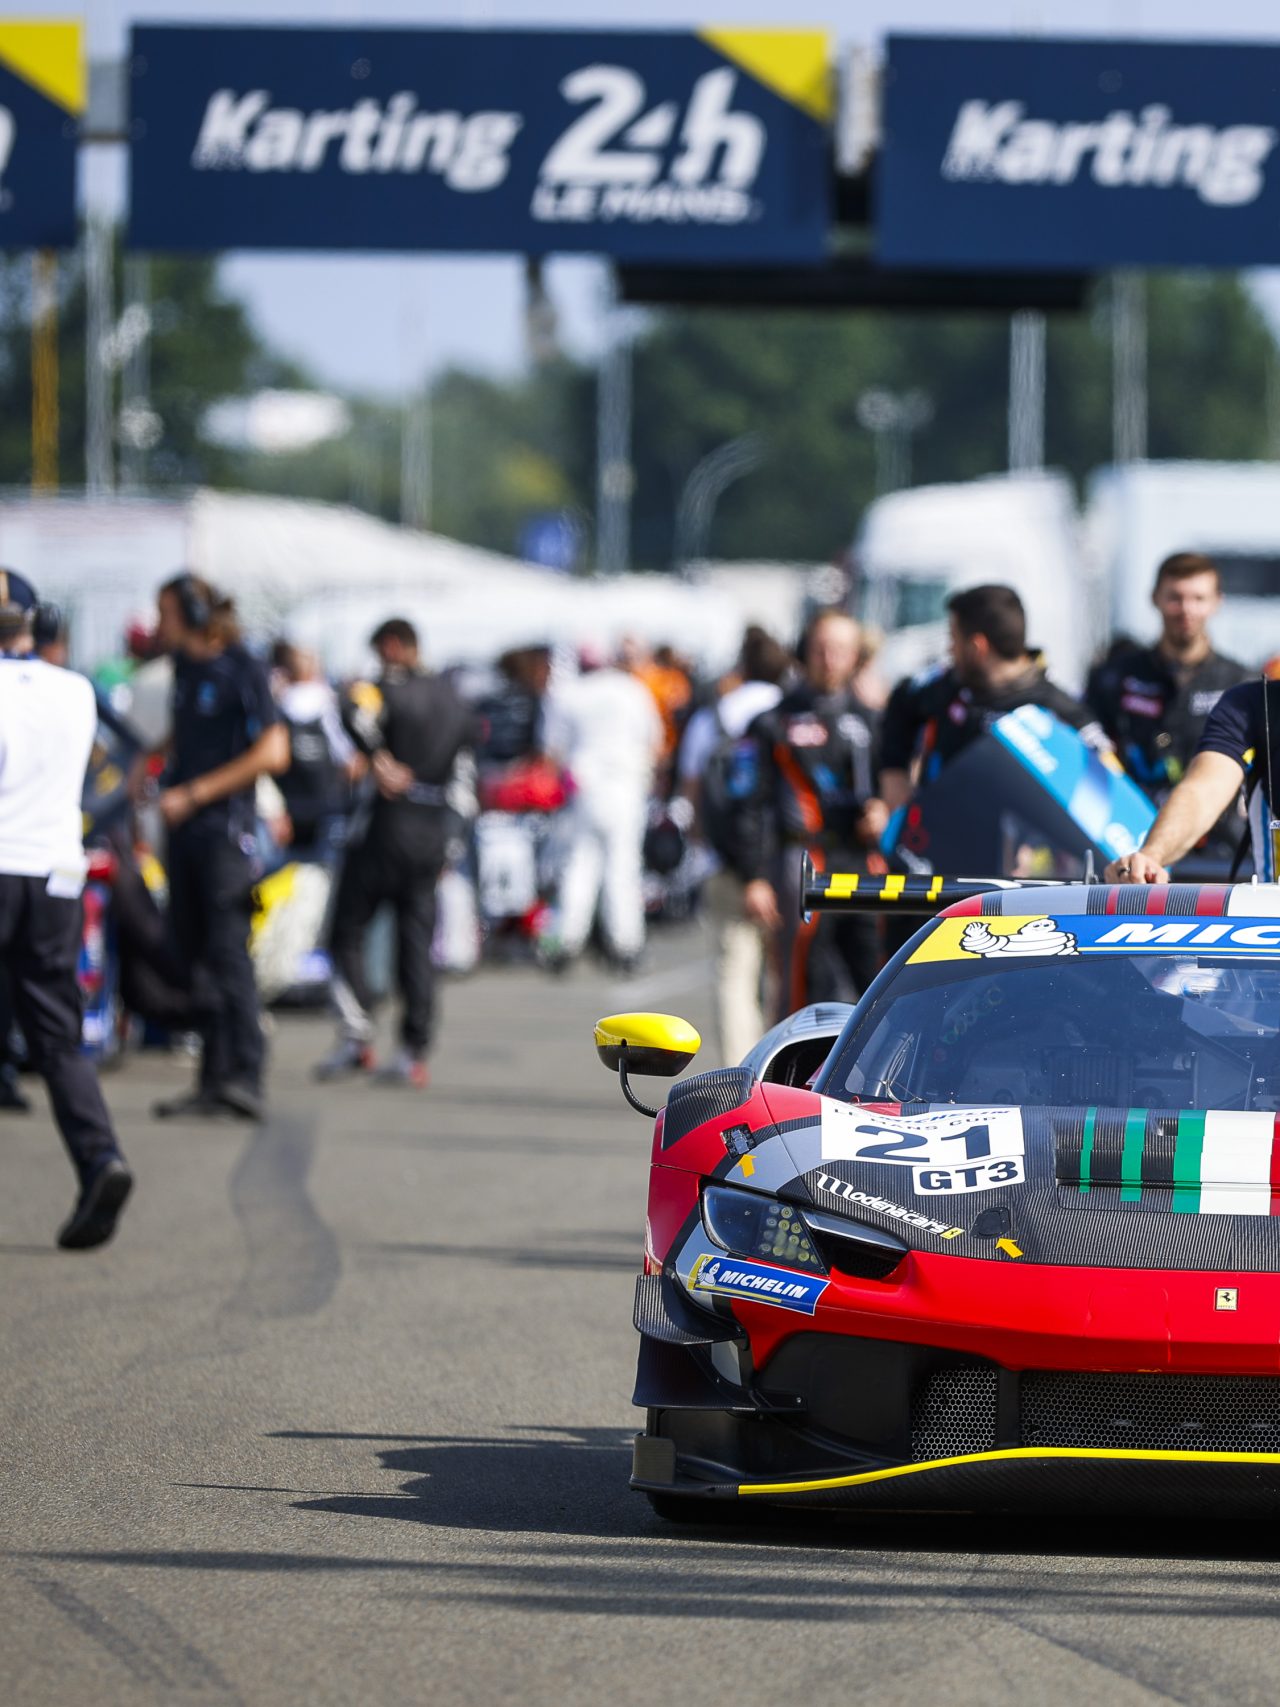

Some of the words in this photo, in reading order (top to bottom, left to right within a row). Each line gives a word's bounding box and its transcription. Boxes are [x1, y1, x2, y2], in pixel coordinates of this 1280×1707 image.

[196, 90, 520, 191] Karting
[944, 101, 1274, 205] Karting
[531, 186, 597, 221] LE
[601, 187, 750, 223] MANS
[855, 1124, 991, 1163] 21
[919, 1160, 1018, 1190] GT3
[718, 1270, 810, 1299] MICHELIN
